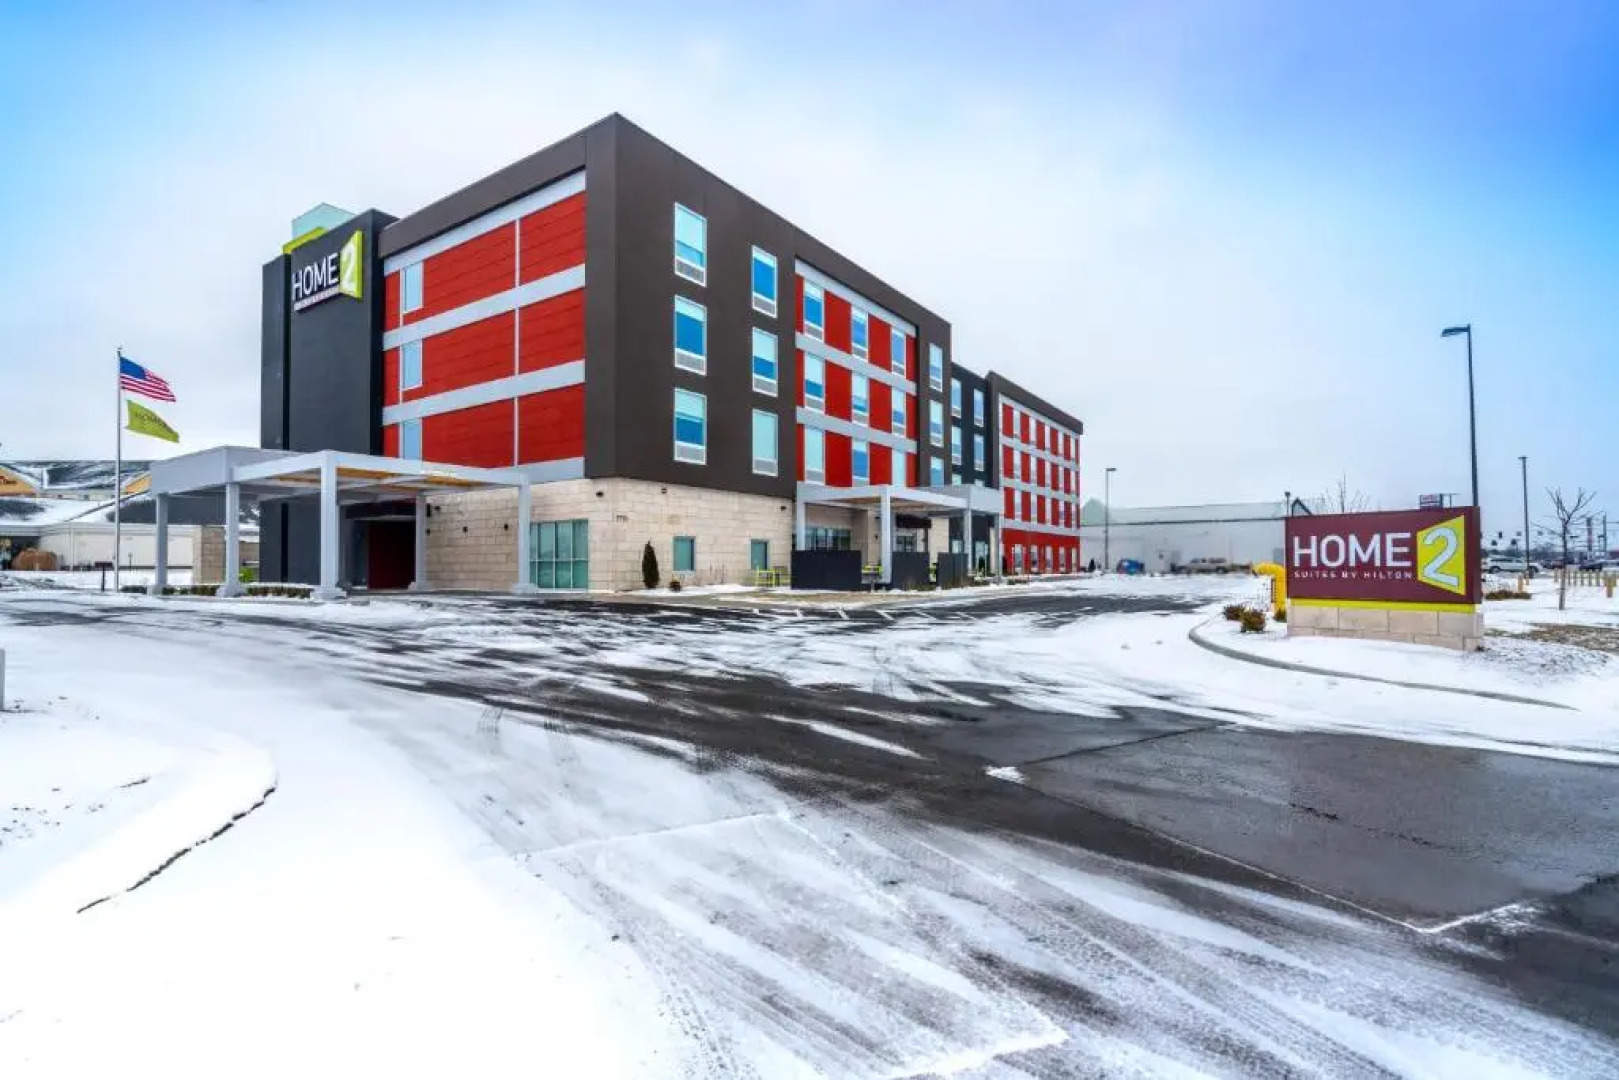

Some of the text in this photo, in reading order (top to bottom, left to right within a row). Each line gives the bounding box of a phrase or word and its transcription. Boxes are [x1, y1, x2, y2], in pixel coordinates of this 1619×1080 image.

[292, 252, 338, 301] HOME
[341, 239, 356, 293] 2
[1293, 526, 1460, 586] HOME 2
[1294, 570, 1413, 580] SUITES BY HILTON
